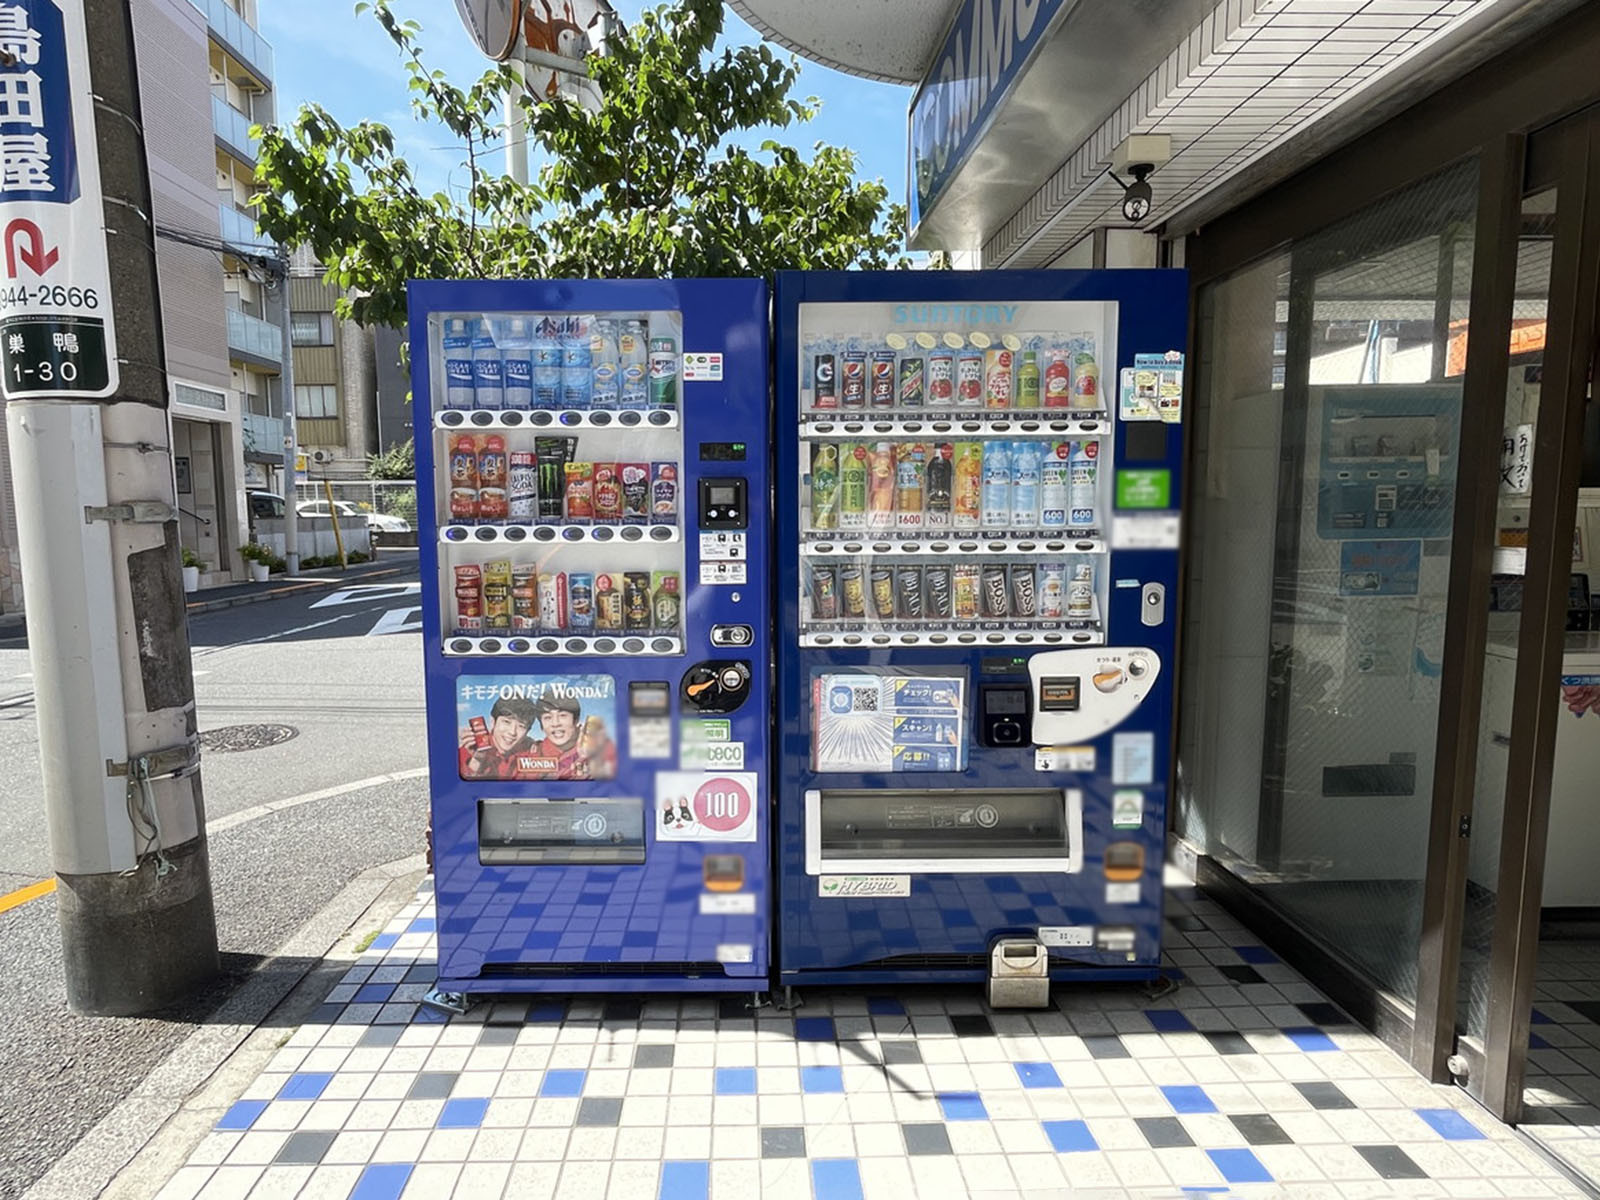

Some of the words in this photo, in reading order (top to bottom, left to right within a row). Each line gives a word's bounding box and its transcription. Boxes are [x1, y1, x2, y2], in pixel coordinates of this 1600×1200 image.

[0, 285, 98, 309] 944-2666
[536, 316, 580, 335] Asahi
[895, 304, 1018, 324] SUNTORY
[13, 361, 77, 382] 1-30
[991, 578, 1006, 616] BOSS
[1020, 578, 1034, 616] BOSS
[705, 791, 740, 818] 100
